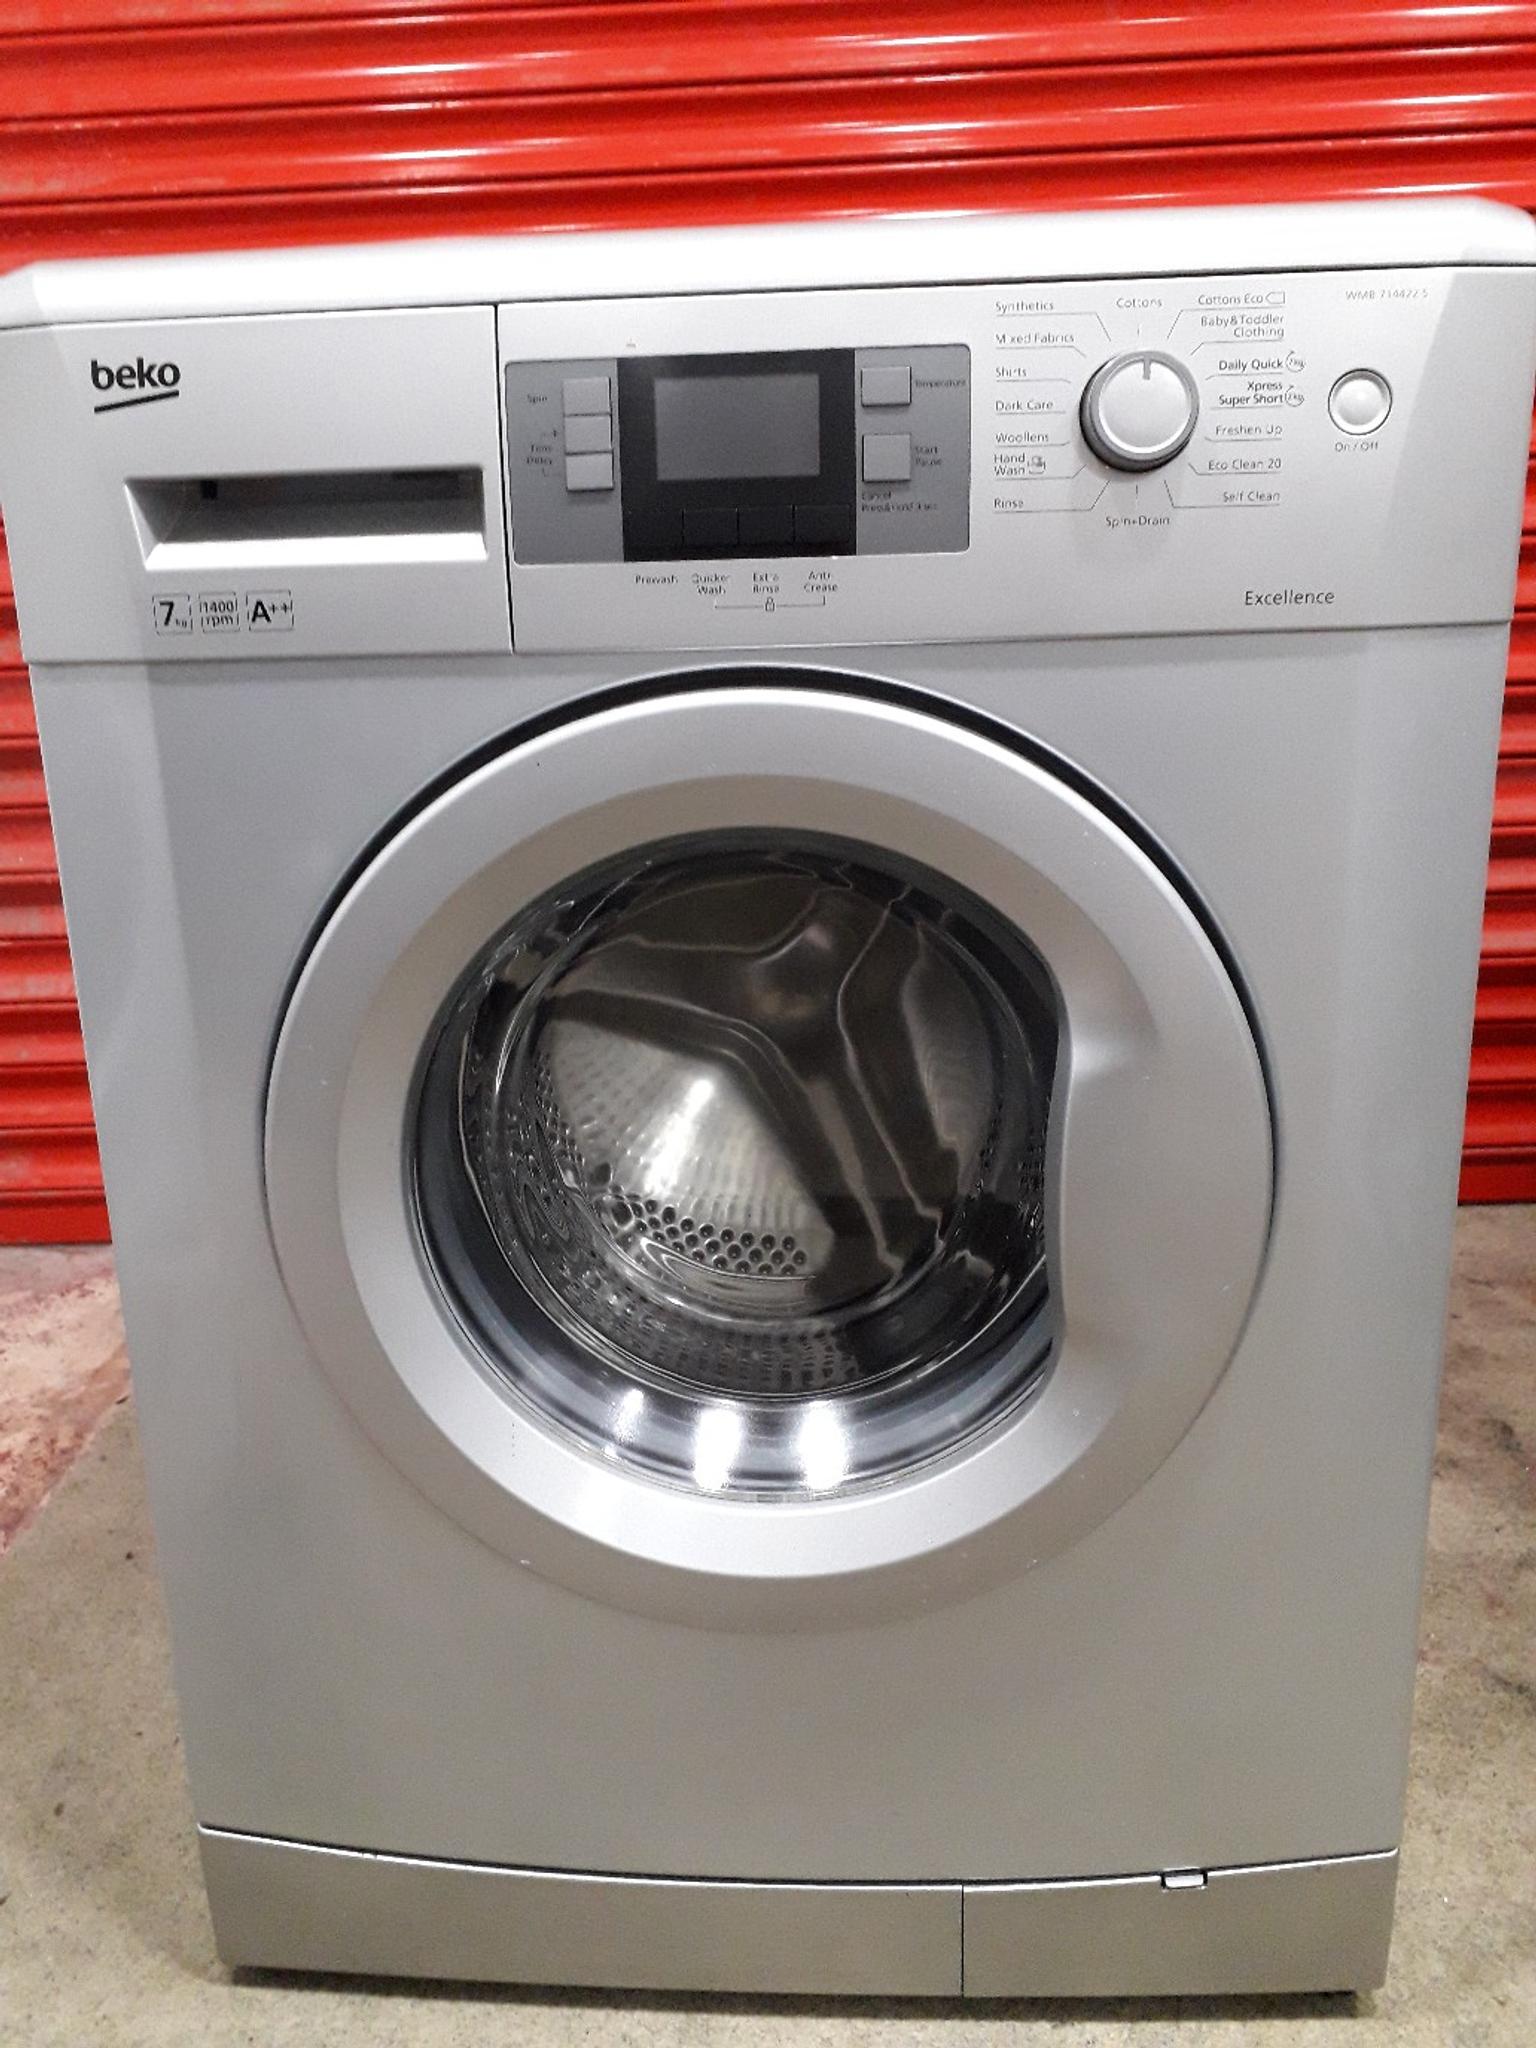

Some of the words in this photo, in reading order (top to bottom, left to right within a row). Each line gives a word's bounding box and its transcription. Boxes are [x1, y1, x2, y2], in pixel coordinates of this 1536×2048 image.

[1116, 297, 1163, 309] Cottons
[1198, 294, 1241, 305] Cottons
[1244, 293, 1264, 304] Eco
[995, 300, 1054, 314] Synthetics
[995, 333, 1031, 345] Mixed
[1034, 332, 1075, 344] Fabrics
[1233, 326, 1285, 340] Clothing
[1218, 358, 1248, 373] Daily
[1251, 358, 1283, 370] Quick
[90, 356, 181, 391] beko
[995, 366, 1027, 378] Shirts
[1247, 381, 1283, 392] Xpress
[995, 400, 1023, 412] Dark
[1026, 399, 1054, 411] Care
[1218, 394, 1251, 408] Super
[1253, 393, 1283, 404] Short
[1215, 424, 1262, 436] Freshen
[1265, 424, 1283, 436] Up
[994, 431, 1050, 443] Woollens
[993, 452, 1026, 464] Hand
[993, 464, 1026, 476] Wash
[1208, 460, 1229, 471] Eco
[1232, 458, 1264, 470] Clean
[1267, 458, 1281, 469] 20
[1223, 491, 1244, 503] Self
[1247, 491, 1281, 502] Clean
[993, 498, 1024, 509] Rinse
[1105, 514, 1171, 529] Spin+Drain
[635, 574, 679, 585] Prewash
[696, 584, 727, 596] Wash
[752, 583, 780, 594] Rinse
[803, 582, 839, 594] Crease
[1244, 589, 1335, 606] Excellence
[202, 600, 235, 614] 1400
[251, 600, 292, 624] A++
[205, 614, 235, 628] rpm
